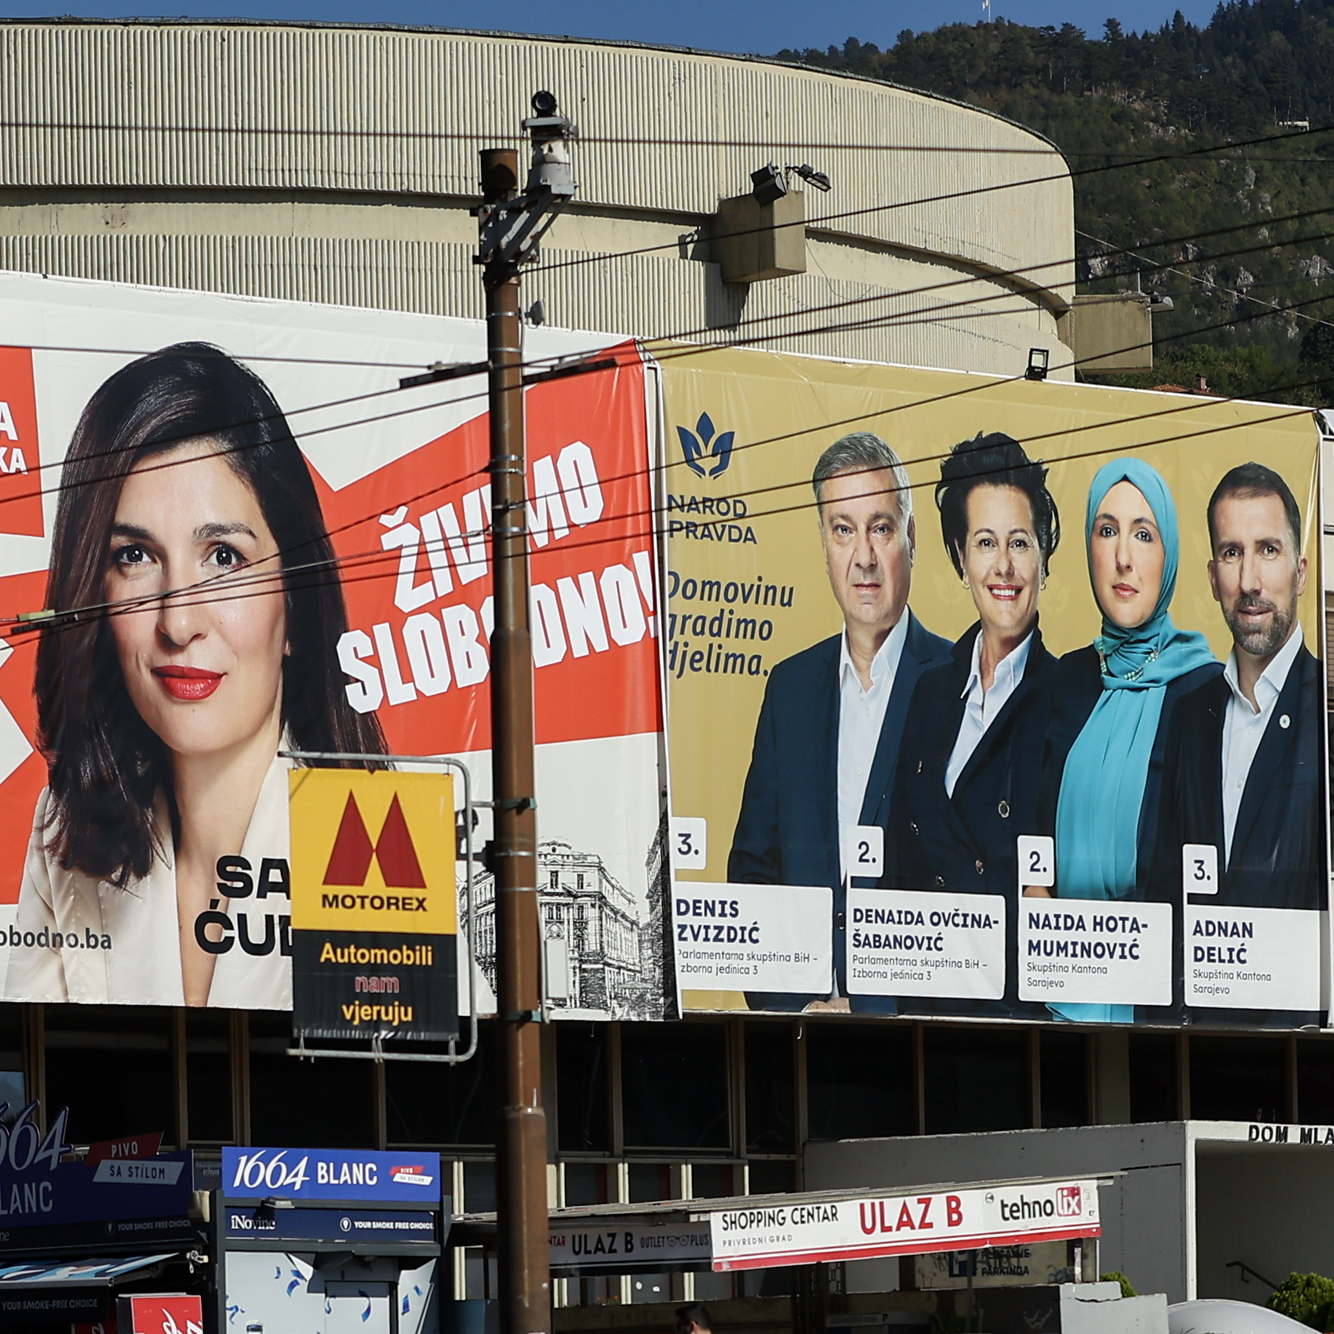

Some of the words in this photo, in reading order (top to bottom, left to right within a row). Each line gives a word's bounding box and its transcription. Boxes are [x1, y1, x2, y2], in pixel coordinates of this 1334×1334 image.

[667, 494, 748, 518] NAROD
[378, 441, 605, 613] ŽIVMO
[669, 520, 758, 544] PRAVDA
[668, 571, 794, 608] Domovinu
[336, 550, 660, 714] SLOBDNO!
[677, 833, 699, 855] 3.
[858, 841, 877, 863] 2.
[1029, 851, 1047, 872] 2.
[1193, 859, 1211, 881] 3.
[321, 894, 427, 912] MOTOREX
[676, 899, 739, 918] DENIS
[853, 908, 925, 926] DENAIDA
[929, 908, 999, 929] OVČINA-
[1028, 912, 1087, 932] NAIDA
[1093, 915, 1148, 934] HOTA-
[1192, 919, 1253, 939] ADNAN
[677, 921, 760, 944] ZVIZDIĆ
[852, 929, 943, 951] ŠABANOVIĆ
[320, 943, 433, 966] Automobili
[746, 950, 791, 964] skupština
[794, 952, 810, 962] BiH
[1027, 938, 1140, 960] MUMINOVIĆ
[1193, 942, 1247, 965] DELIĆ
[716, 965, 750, 976] jedinica
[753, 965, 758, 974] 3
[853, 954, 917, 967] Parlamentarna
[920, 958, 962, 970] skupština
[965, 959, 979, 969] BiH
[1027, 962, 1069, 975] Skupština
[1072, 964, 1108, 974] Kantona
[355, 976, 399, 993] nam
[853, 968, 887, 979] Izborna
[890, 970, 923, 981] jedinica
[926, 971, 931, 981] 3
[1027, 977, 1064, 989] Sarajevo
[1193, 969, 1234, 981] Skupština
[1236, 971, 1272, 981] Kantona
[1193, 984, 1230, 996] Sarajevo
[342, 1001, 413, 1026] vjeruju
[1249, 1125, 1288, 1143] DOM
[111, 1141, 138, 1157] PIVO
[109, 1165, 123, 1177] SA
[232, 1150, 310, 1191] 1664
[317, 1162, 378, 1186] BLANC
[118, 1222, 133, 1232] YOUR
[134, 1221, 154, 1231] SMOKE
[155, 1220, 168, 1230] FREE
[168, 1219, 191, 1229] CHOICE
[231, 1215, 276, 1230] iNovine
[354, 1221, 371, 1229] YOUR
[372, 1221, 393, 1230] SMOKE
[395, 1222, 409, 1230] FREE
[409, 1222, 434, 1230] CHOICE
[722, 1208, 786, 1232] SHOPPING
[791, 1205, 839, 1225] CENTAR
[859, 1197, 934, 1235] ULAZ
[945, 1195, 963, 1228] B
[572, 1233, 617, 1255] ULAZ
[625, 1232, 634, 1253] B
[640, 1236, 665, 1248] OUTLET
[690, 1235, 709, 1246] PLUS
[723, 1236, 767, 1247] PRIVREDNI
[769, 1234, 793, 1245] GRAD
[2, 1301, 22, 1311] YOUR
[69, 1299, 98, 1309] CHOICE
